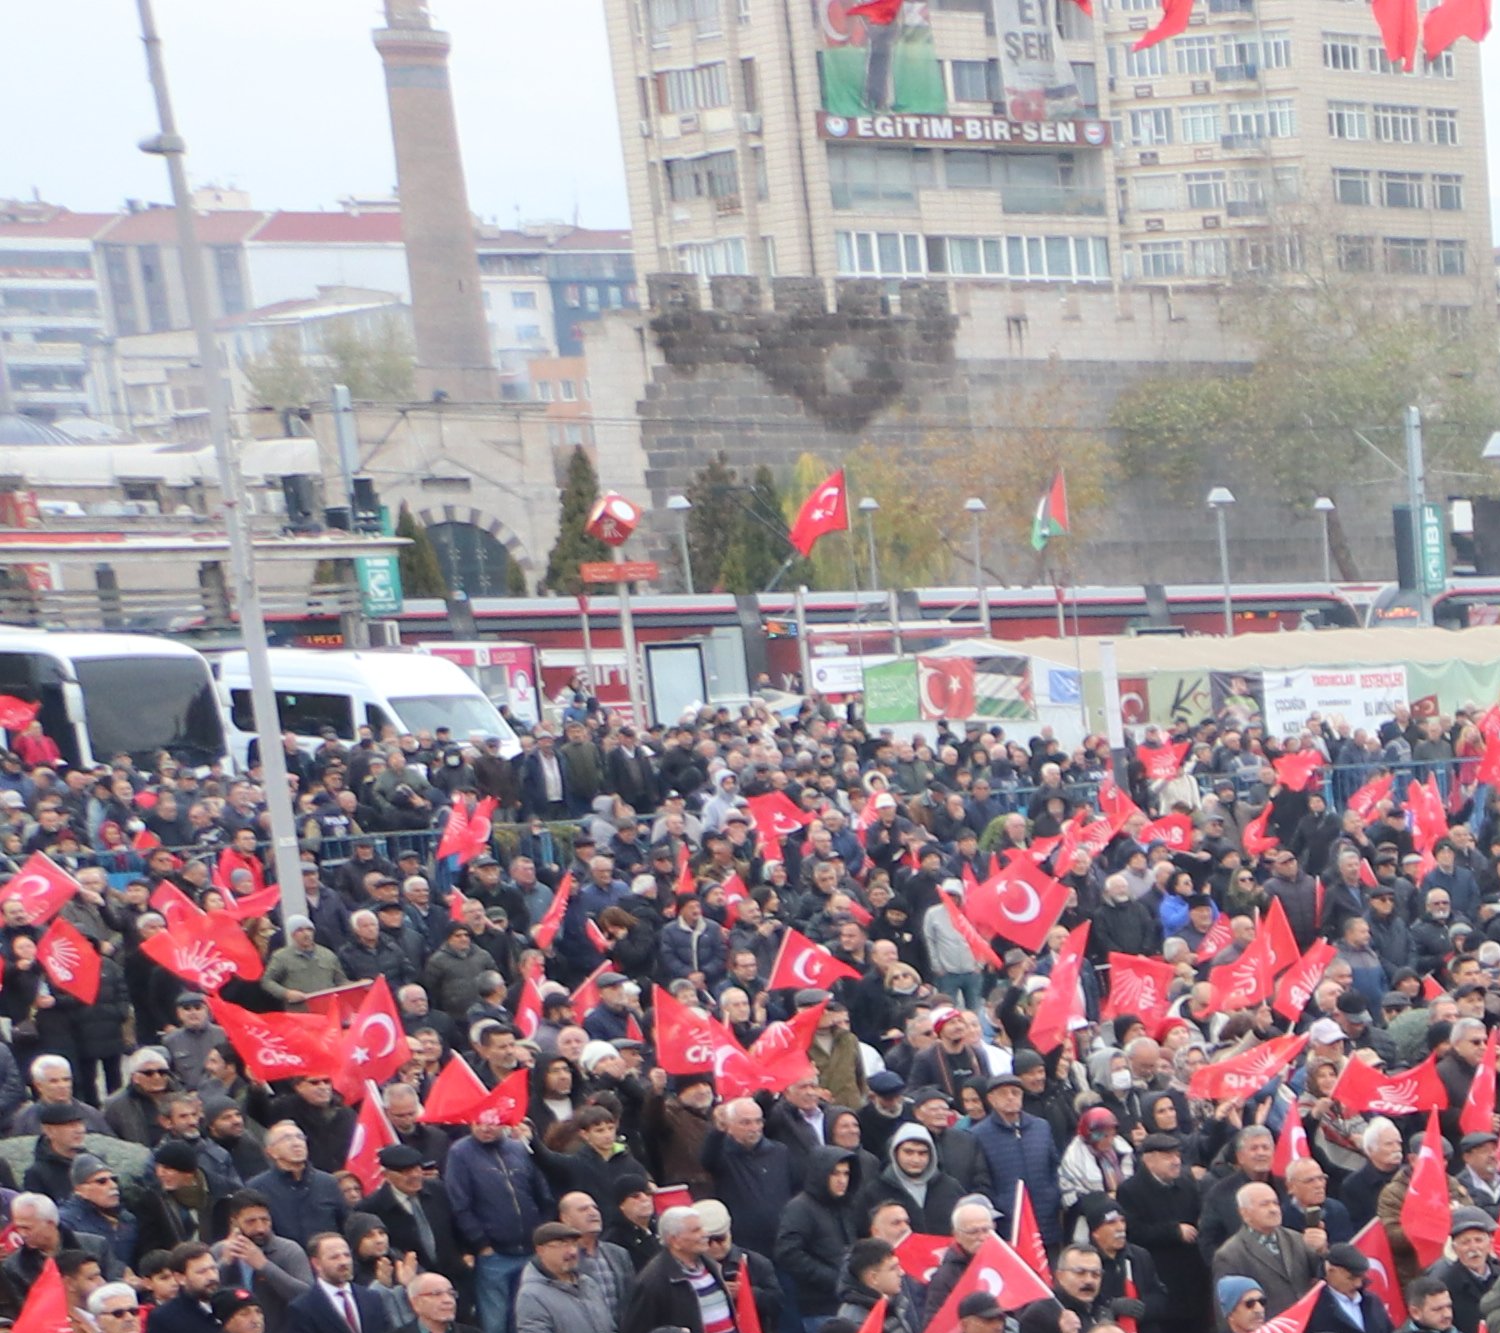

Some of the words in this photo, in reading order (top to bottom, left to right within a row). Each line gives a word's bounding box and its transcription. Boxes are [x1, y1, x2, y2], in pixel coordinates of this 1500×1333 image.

[257, 1047, 302, 1068] CHP
[687, 1045, 713, 1063] CH
[1369, 1100, 1415, 1114] CHP
